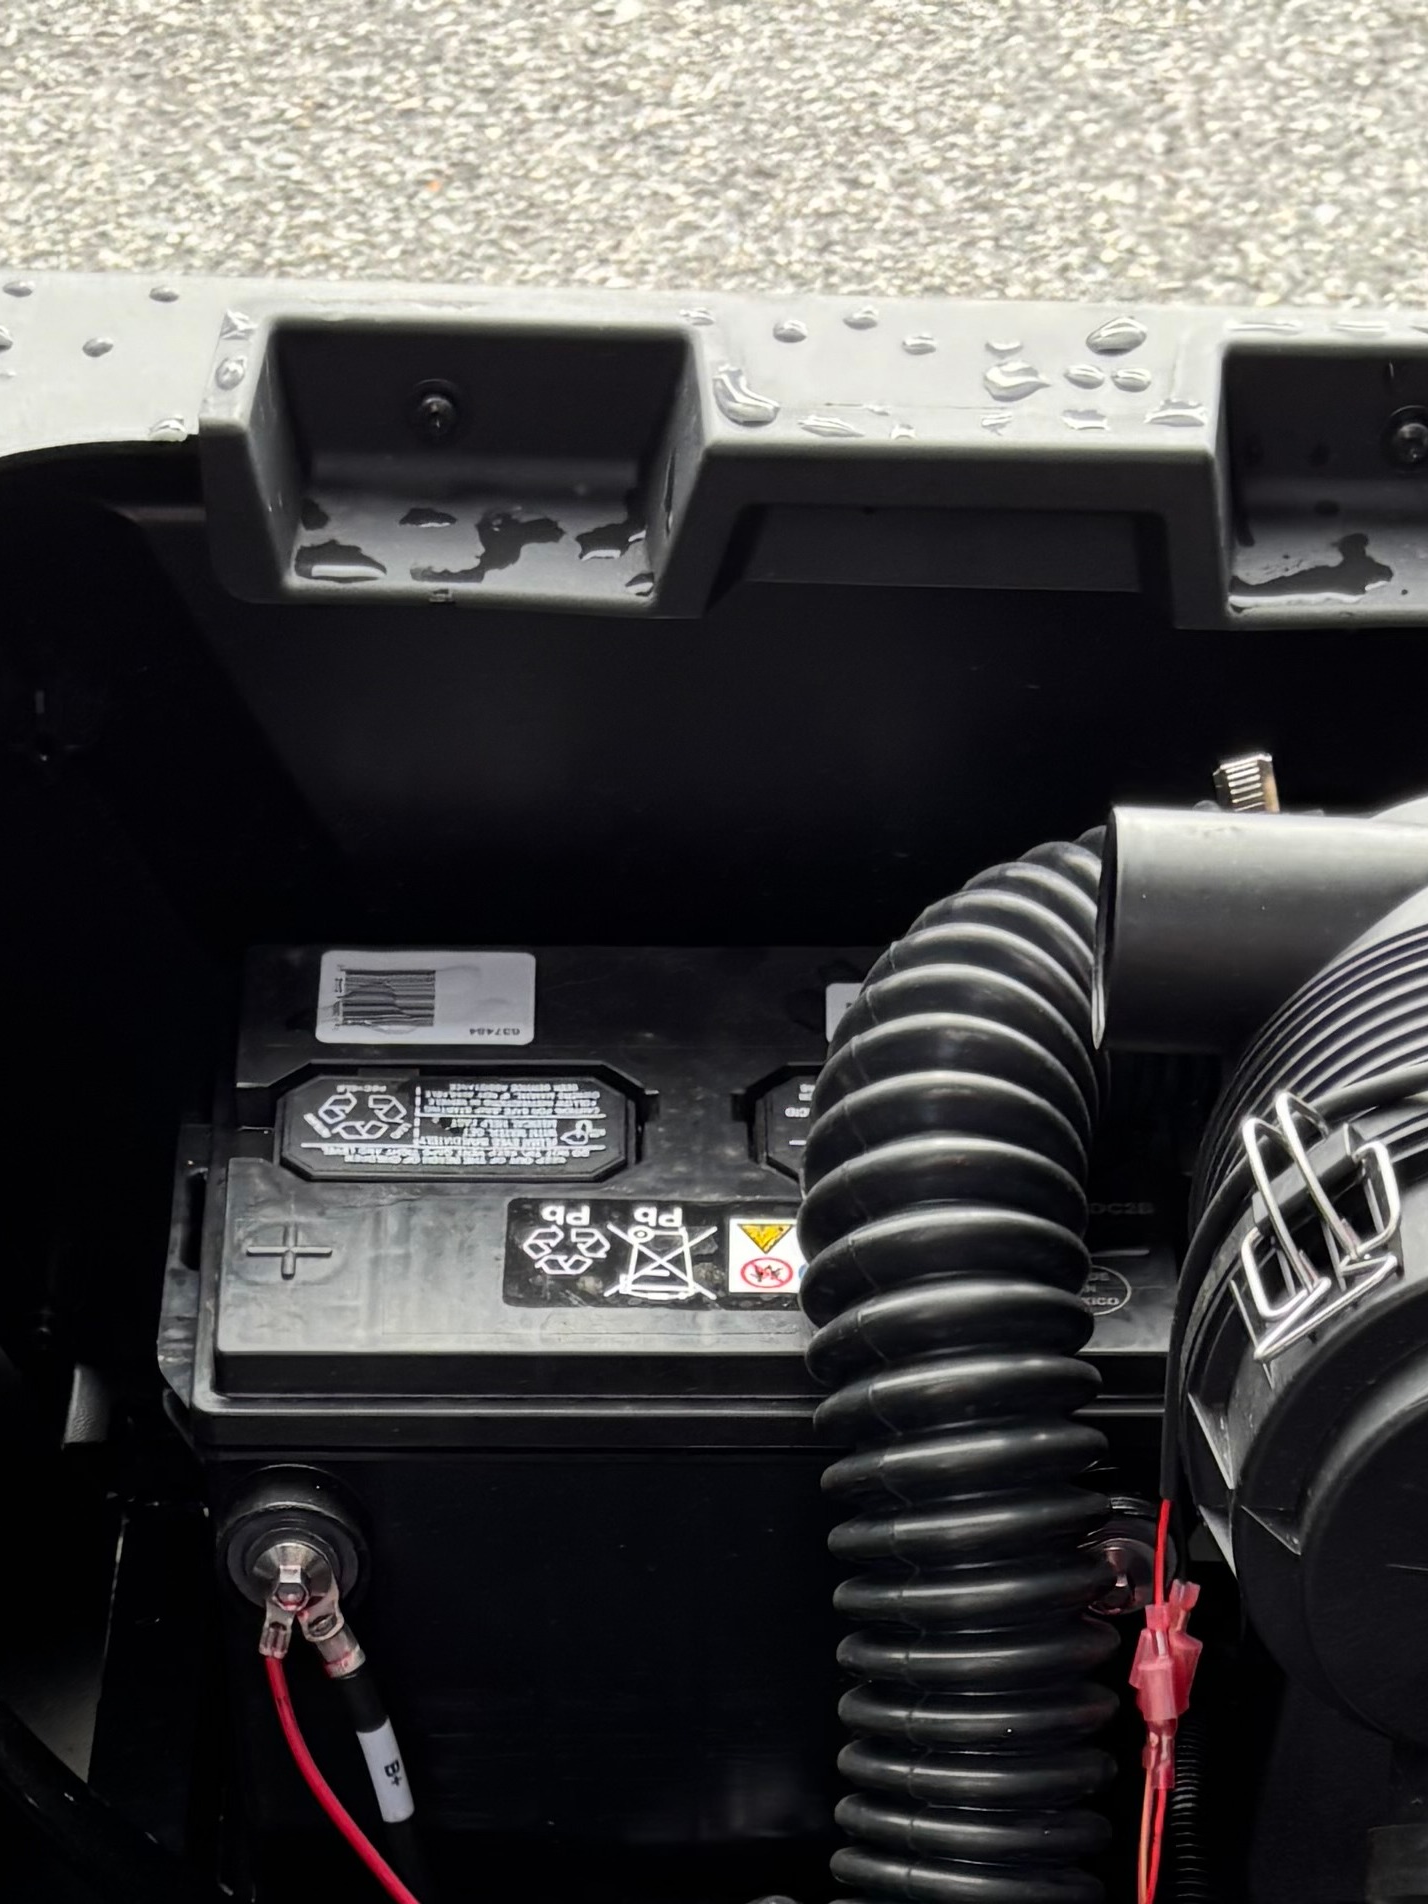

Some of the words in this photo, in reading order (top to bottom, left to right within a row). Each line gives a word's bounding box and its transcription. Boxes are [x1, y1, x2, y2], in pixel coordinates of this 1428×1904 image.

[539, 1204, 590, 1226] Pb
[632, 1206, 682, 1227] Pb
[382, 1758, 404, 1788] B+
